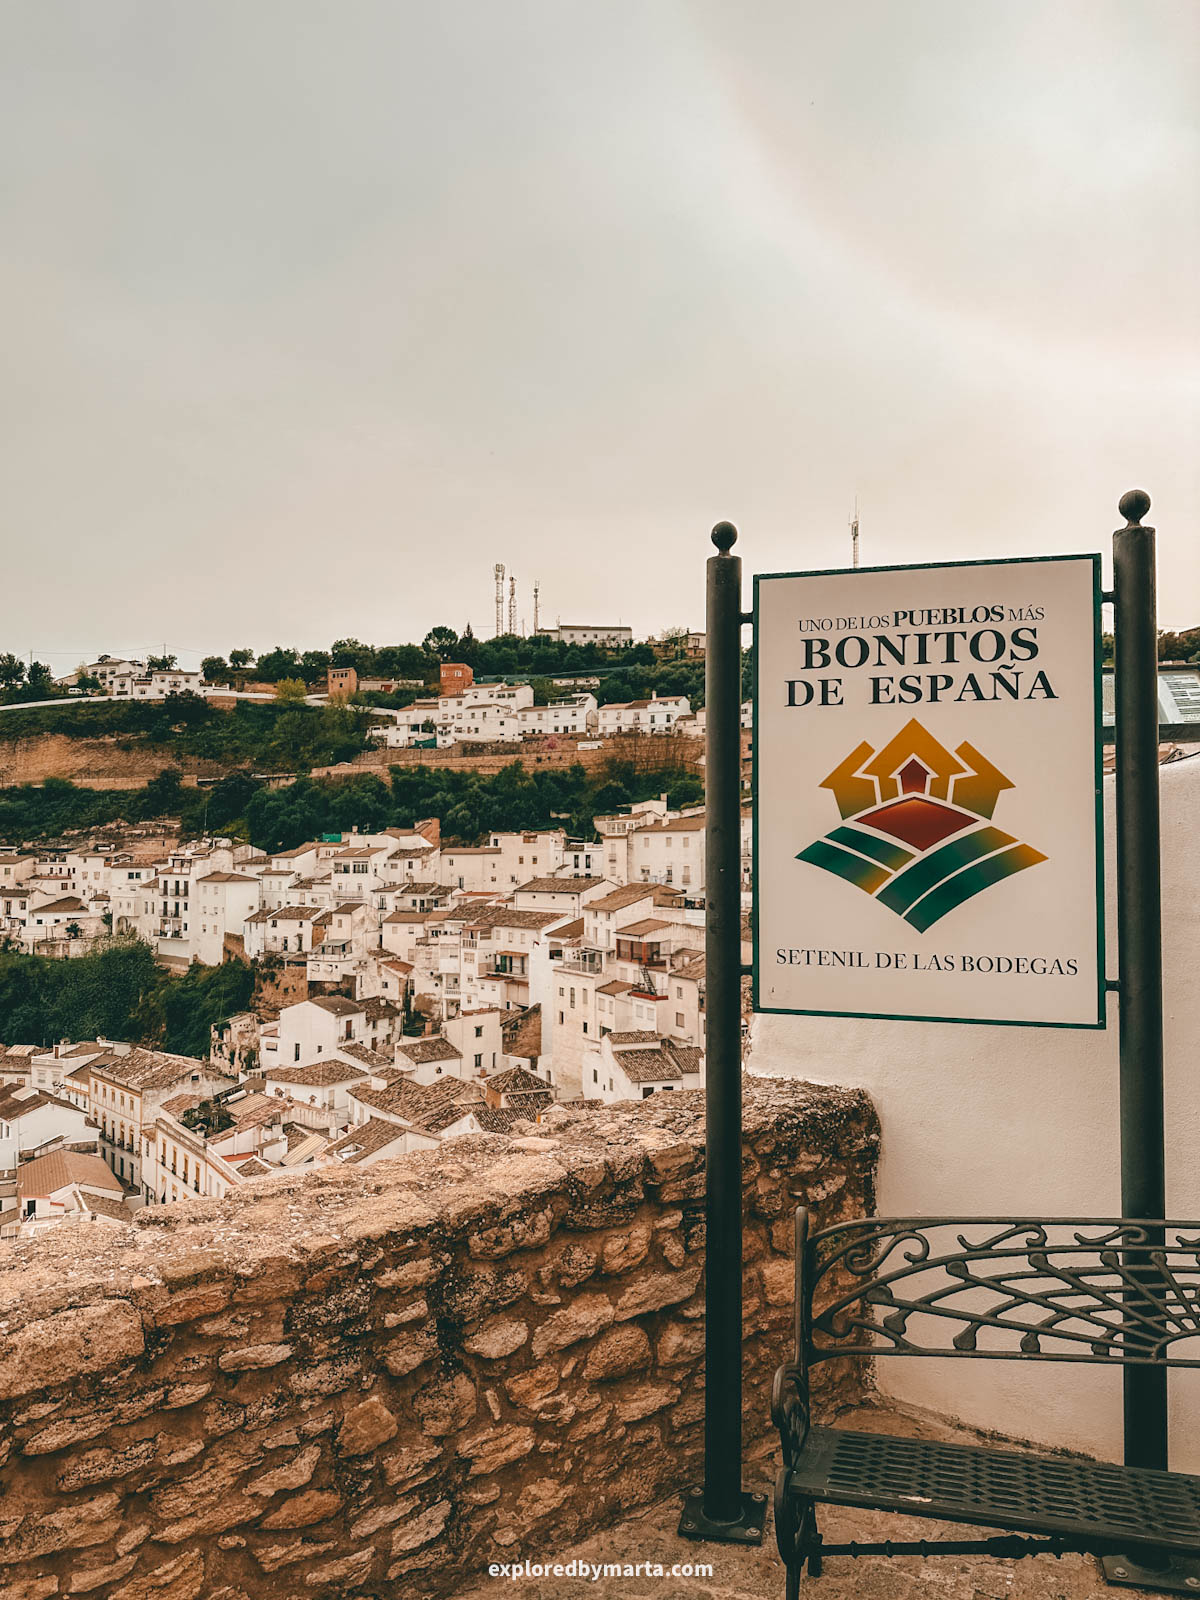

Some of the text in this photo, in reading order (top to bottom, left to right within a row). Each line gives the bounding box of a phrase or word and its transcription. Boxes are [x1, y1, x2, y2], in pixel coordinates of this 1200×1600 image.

[798, 604, 1045, 632] UNO DE LOS PUEBLOS MÁS
[800, 627, 1039, 670] BONITOS
[784, 663, 1060, 708] DE ESPAÑA
[776, 948, 1079, 976] SETENIL DE LAS BODEGAS
